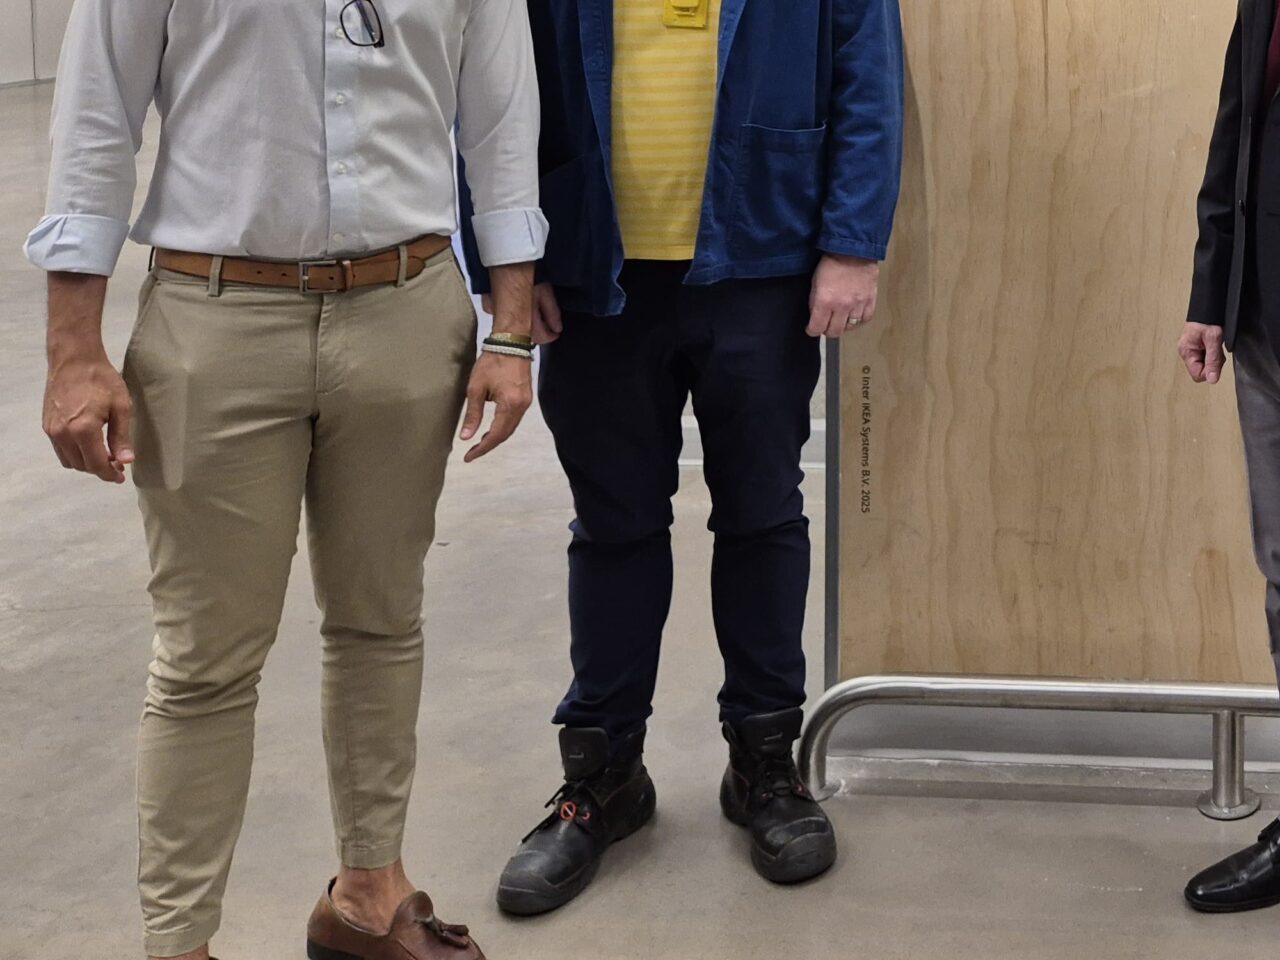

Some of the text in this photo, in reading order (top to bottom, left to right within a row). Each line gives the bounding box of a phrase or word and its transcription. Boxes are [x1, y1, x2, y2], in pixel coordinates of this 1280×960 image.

[862, 376, 871, 401] Inter
[862, 402, 871, 425] IKEA
[860, 427, 871, 467] Systems
[861, 489, 871, 514] 2025
